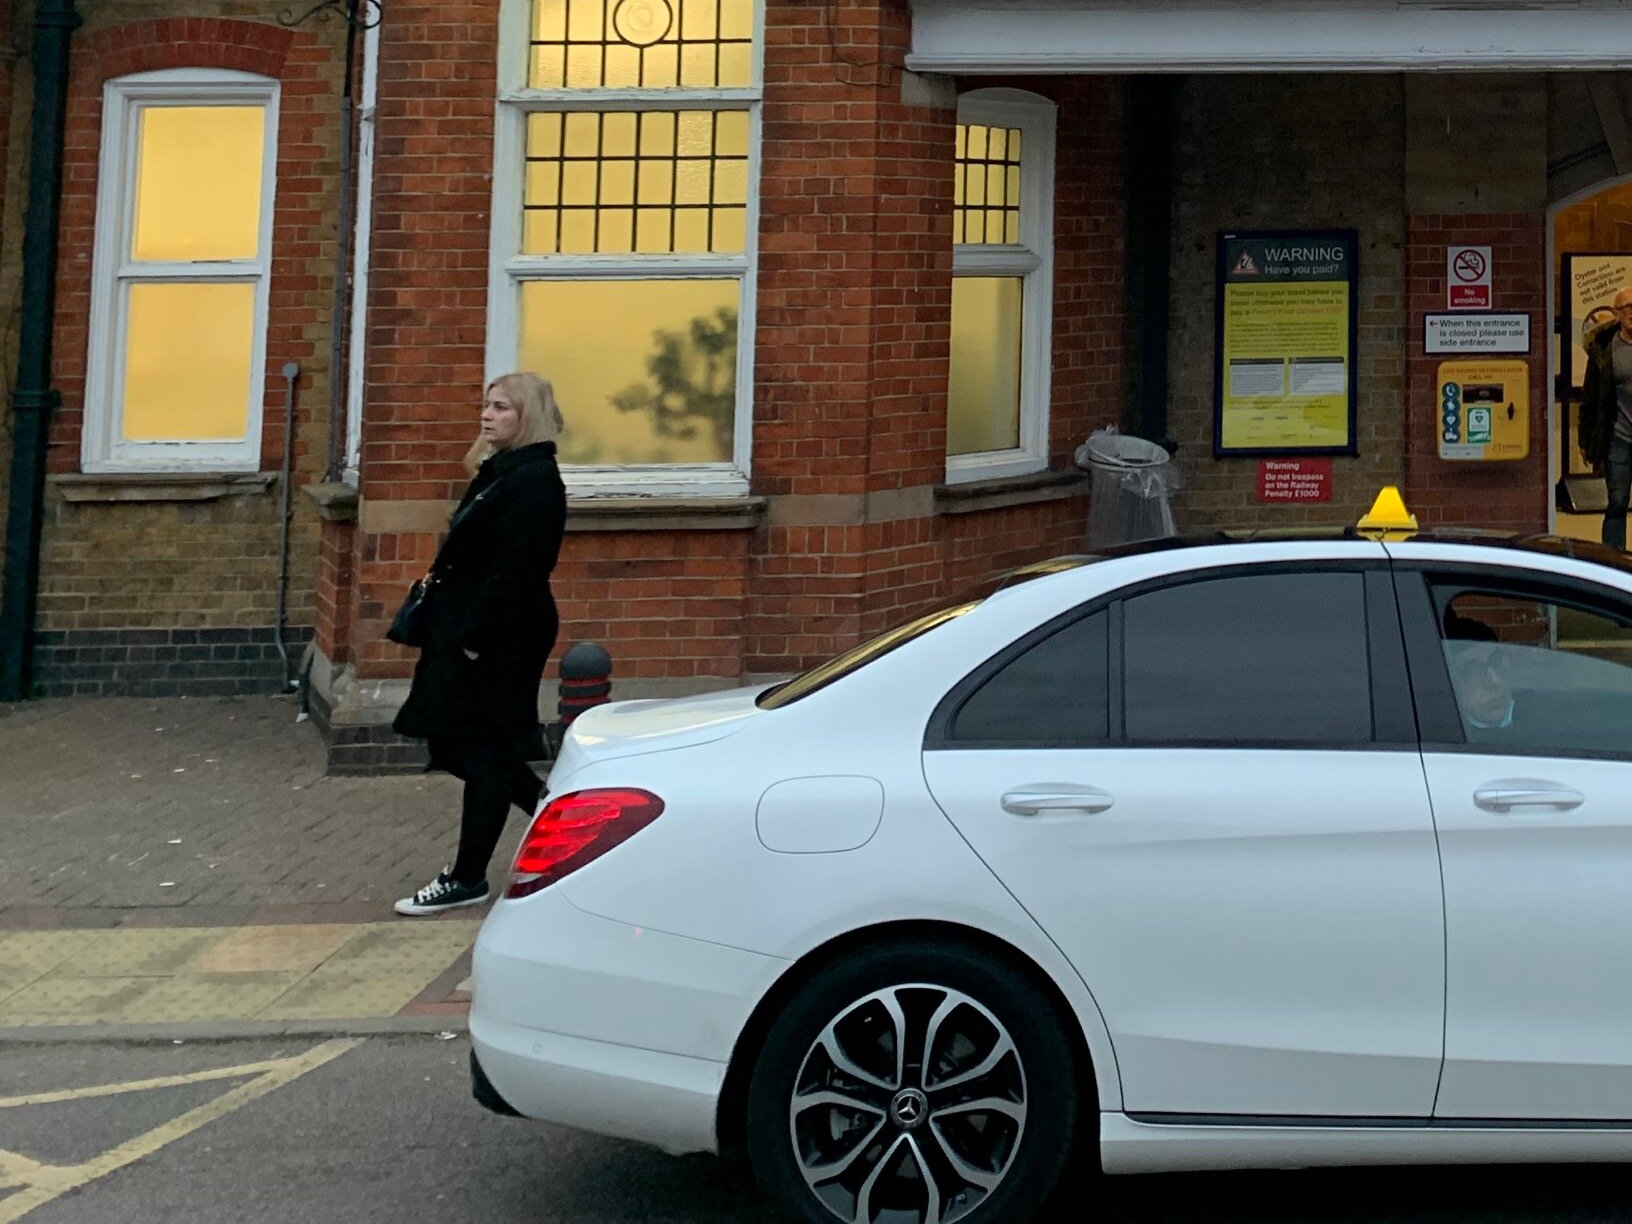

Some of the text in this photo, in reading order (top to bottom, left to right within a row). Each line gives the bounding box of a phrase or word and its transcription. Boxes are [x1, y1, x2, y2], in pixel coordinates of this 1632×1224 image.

[1265, 246, 1344, 261] WARNING
[1264, 265, 1290, 274] Have
[1292, 267, 1310, 276] you
[1311, 264, 1340, 274] paid?
[1575, 262, 1611, 281] Oyster and
[1464, 287, 1476, 295] No
[1580, 288, 1591, 296] not
[1592, 280, 1608, 291] valid
[1454, 297, 1486, 305] smoking
[1439, 319, 1520, 328] When this entrance
[1439, 329, 1525, 338] is closed please use
[1439, 339, 1496, 347] side entrance
[1266, 462, 1299, 471] Warning
[1265, 473, 1324, 481] Do not trespass
[1276, 481, 1289, 489] the
[1290, 481, 1320, 490] Railway
[1265, 490, 1293, 498] Penalty
